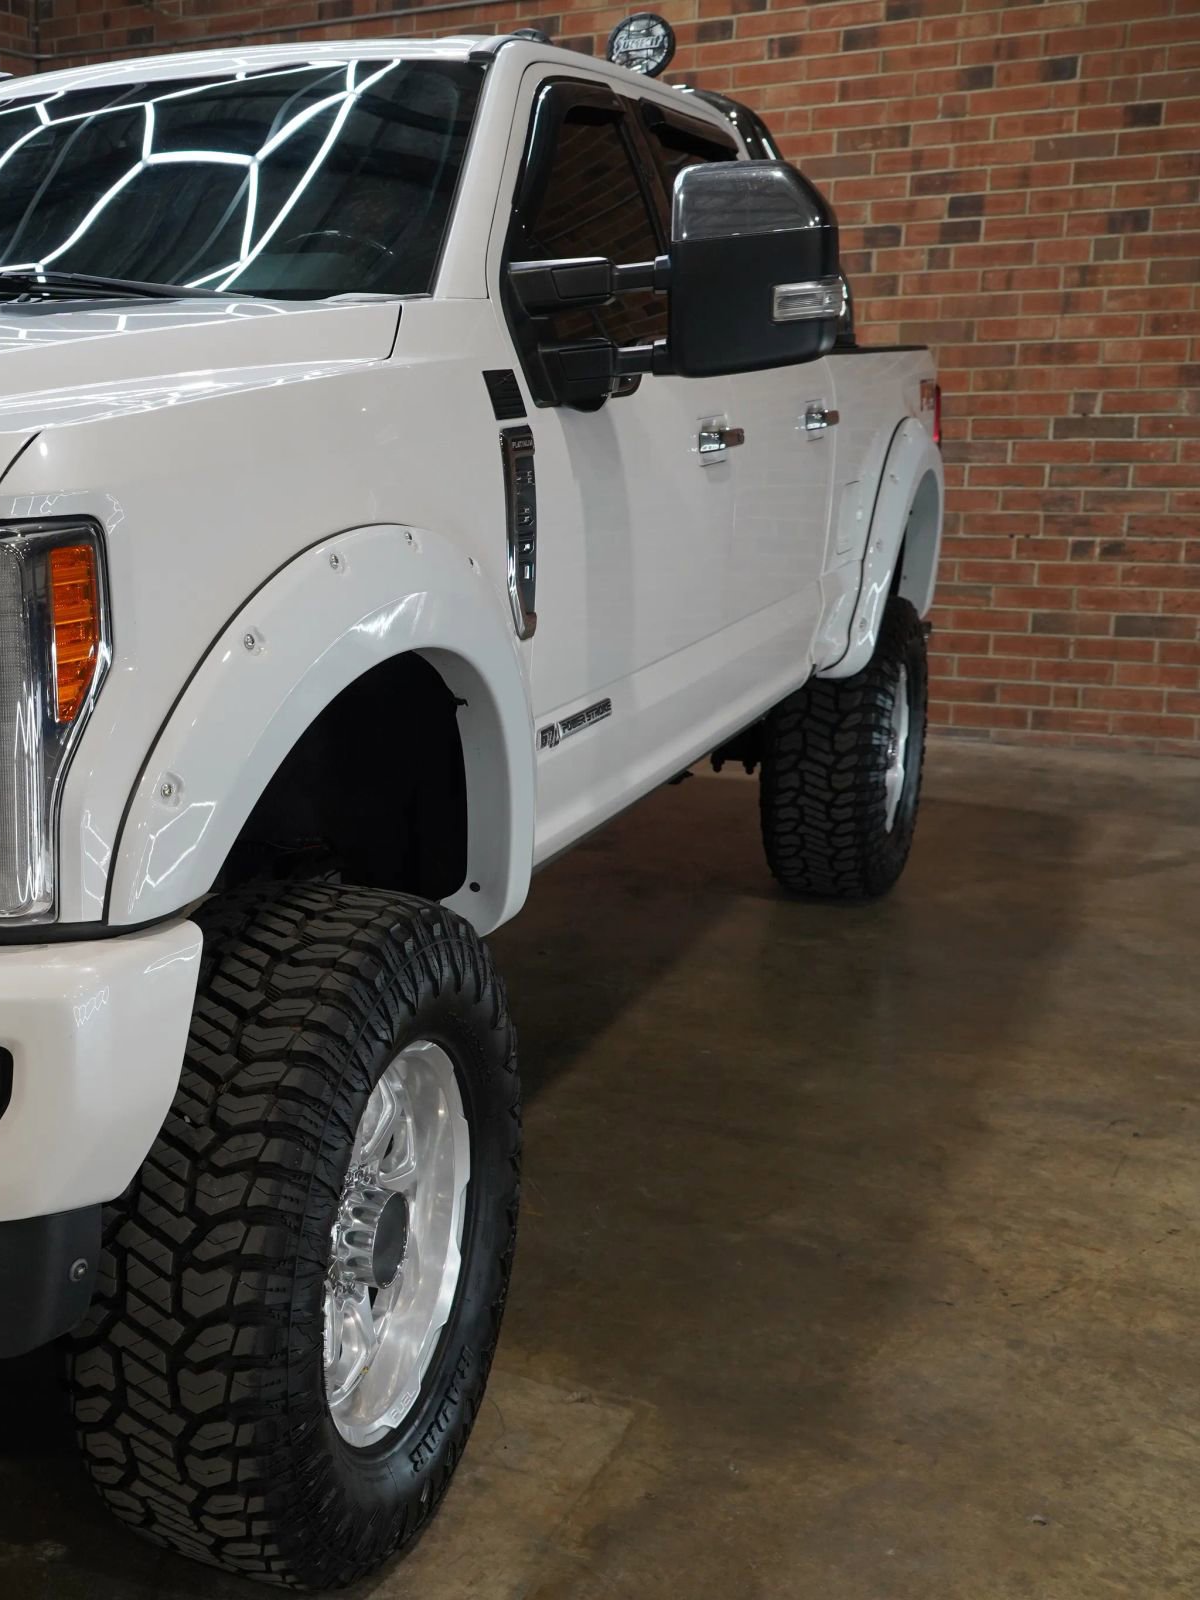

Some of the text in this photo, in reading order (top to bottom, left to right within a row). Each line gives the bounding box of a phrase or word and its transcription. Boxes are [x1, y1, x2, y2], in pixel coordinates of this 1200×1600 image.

[561, 713, 586, 734] POWER
[586, 703, 612, 722] STROKE
[390, 1390, 417, 1420] FUEL
